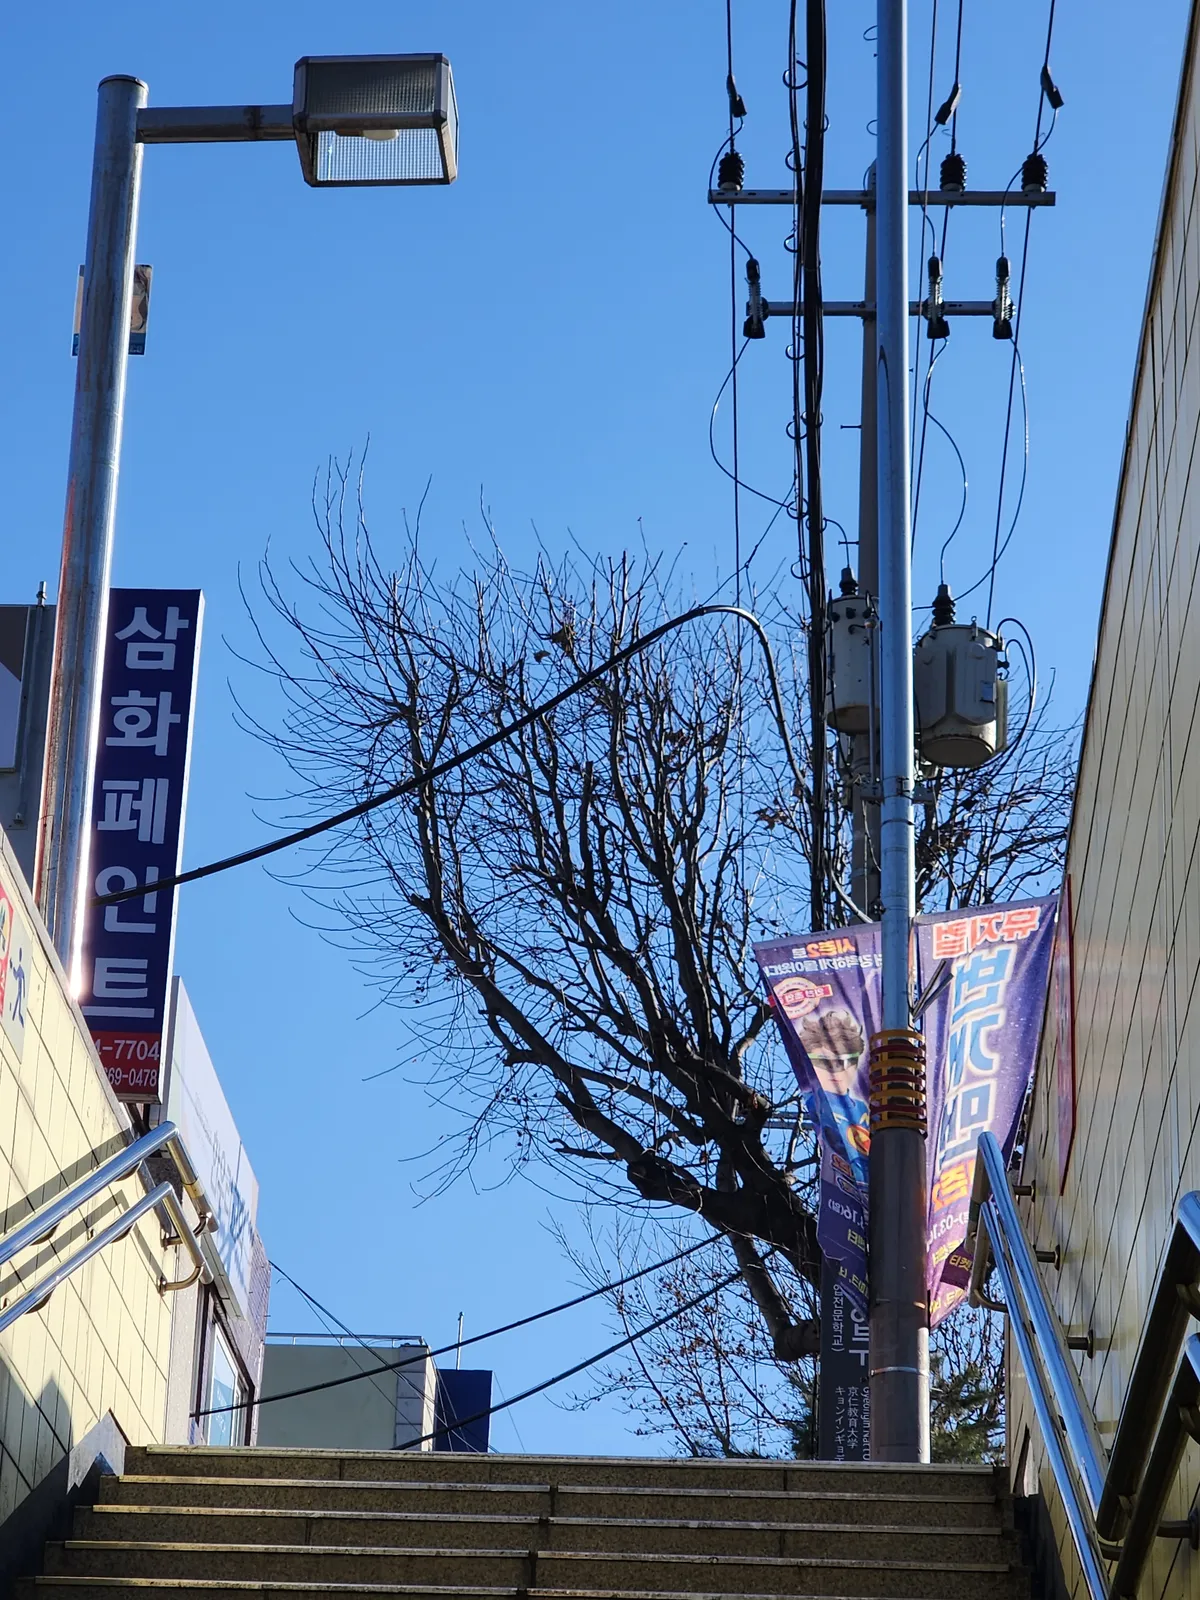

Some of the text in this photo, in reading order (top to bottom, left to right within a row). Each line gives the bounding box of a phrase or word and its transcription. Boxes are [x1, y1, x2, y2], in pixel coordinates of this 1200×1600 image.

[81, 606, 190, 1019] 삼화페인트
[846, 1386, 860, 1450] 京仁教育大学
